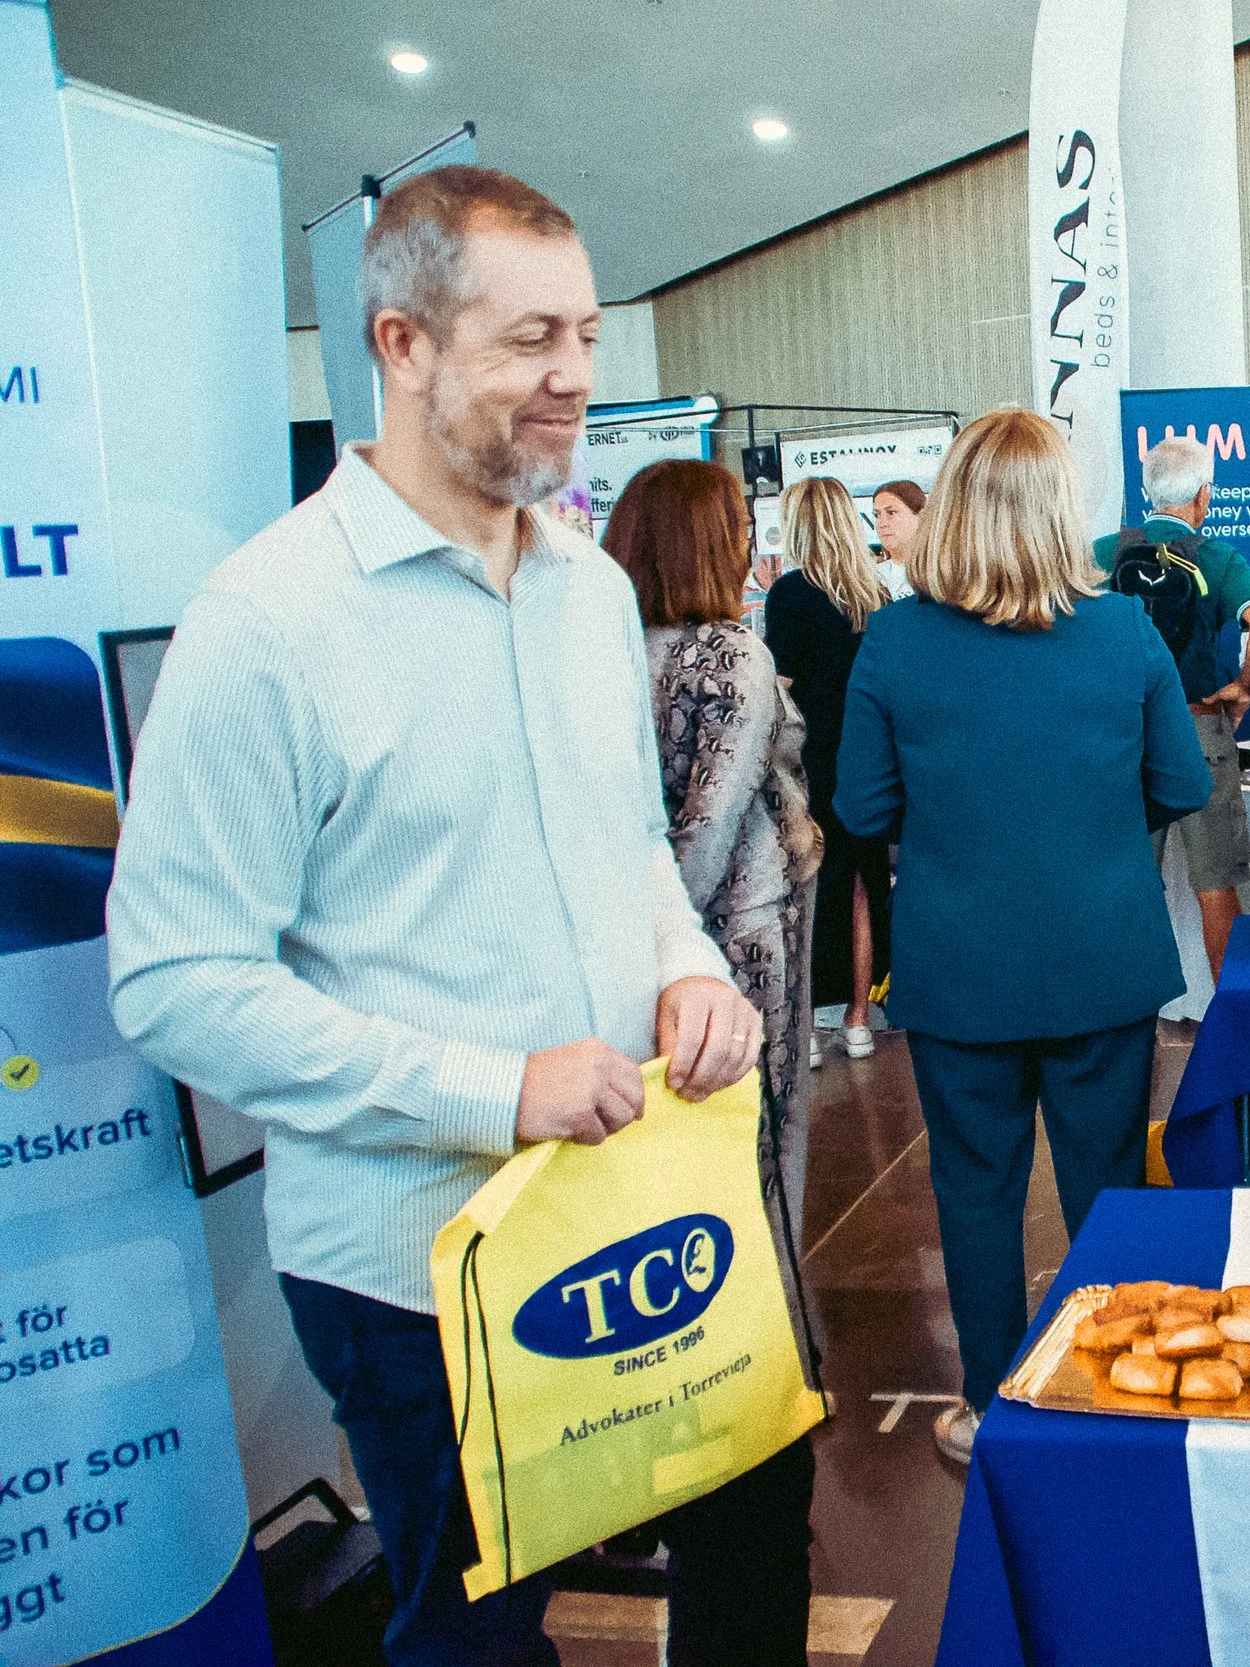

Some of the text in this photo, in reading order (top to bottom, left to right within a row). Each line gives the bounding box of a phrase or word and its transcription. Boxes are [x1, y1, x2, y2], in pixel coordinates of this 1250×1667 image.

[1089, 294, 1117, 368] beds
[586, 431, 622, 446] ERNET
[0, 523, 79, 578] LT
[15, 1303, 68, 1339] för
[613, 1325, 705, 1376] SINCE 1996
[559, 1400, 663, 1447] Advokater
[680, 1352, 752, 1402] Torrevieja
[87, 1426, 181, 1477] som
[64, 1499, 129, 1541] för
